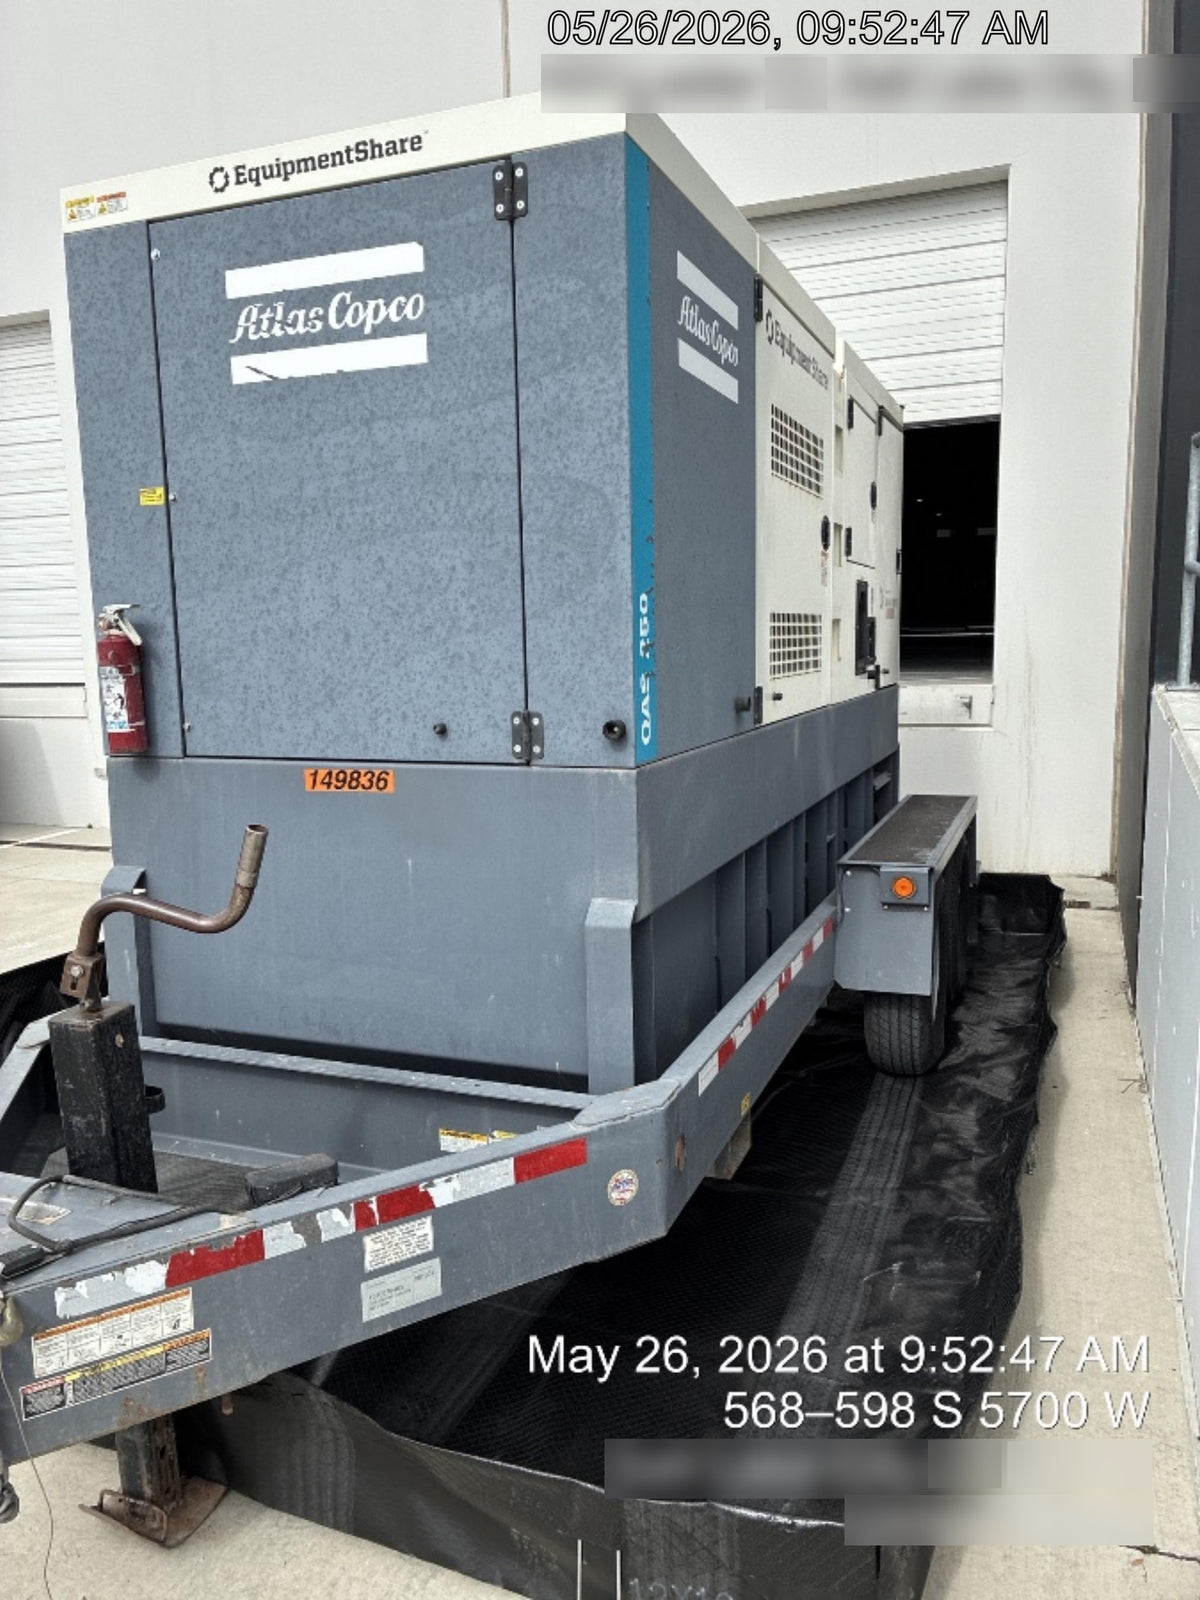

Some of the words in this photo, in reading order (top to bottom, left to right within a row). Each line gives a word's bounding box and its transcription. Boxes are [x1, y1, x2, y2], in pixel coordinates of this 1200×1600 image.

[234, 134, 423, 187] EquipmentShare
[229, 301, 324, 344] Atlas
[327, 291, 425, 335] Copco
[677, 296, 712, 346] Atlas
[710, 319, 739, 367] Copco
[310, 769, 390, 791] 149836
